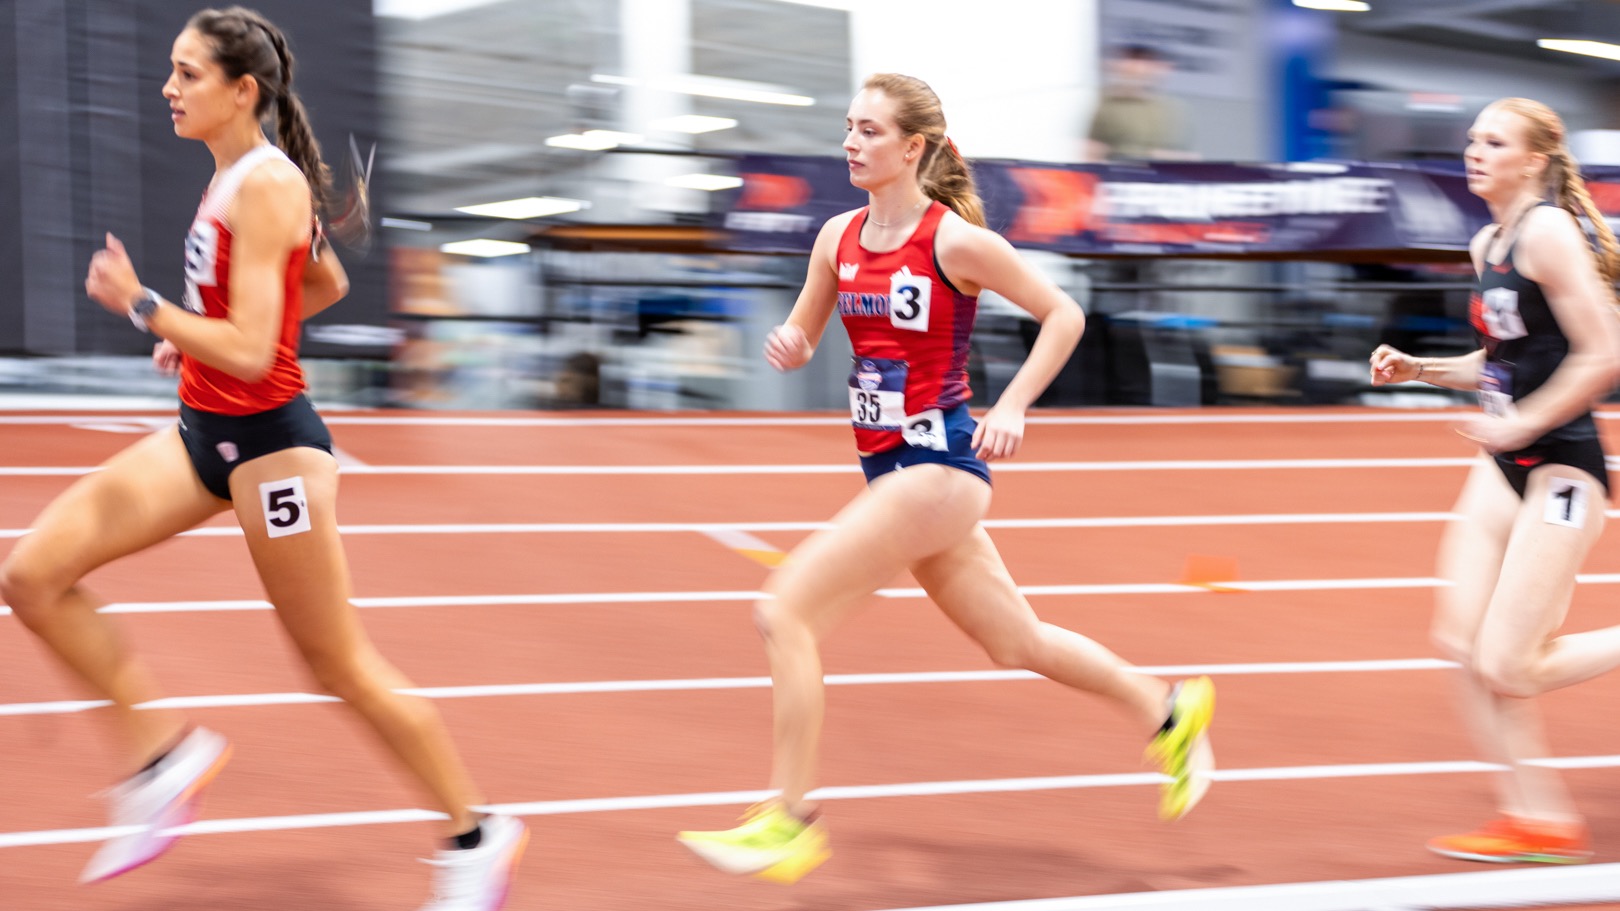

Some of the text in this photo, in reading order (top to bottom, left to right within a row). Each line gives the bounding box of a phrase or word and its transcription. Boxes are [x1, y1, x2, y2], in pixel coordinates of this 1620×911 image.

[894, 285, 920, 320] 3
[857, 392, 880, 422] 35
[268, 486, 300, 528] 5
[1552, 484, 1578, 522] 1
